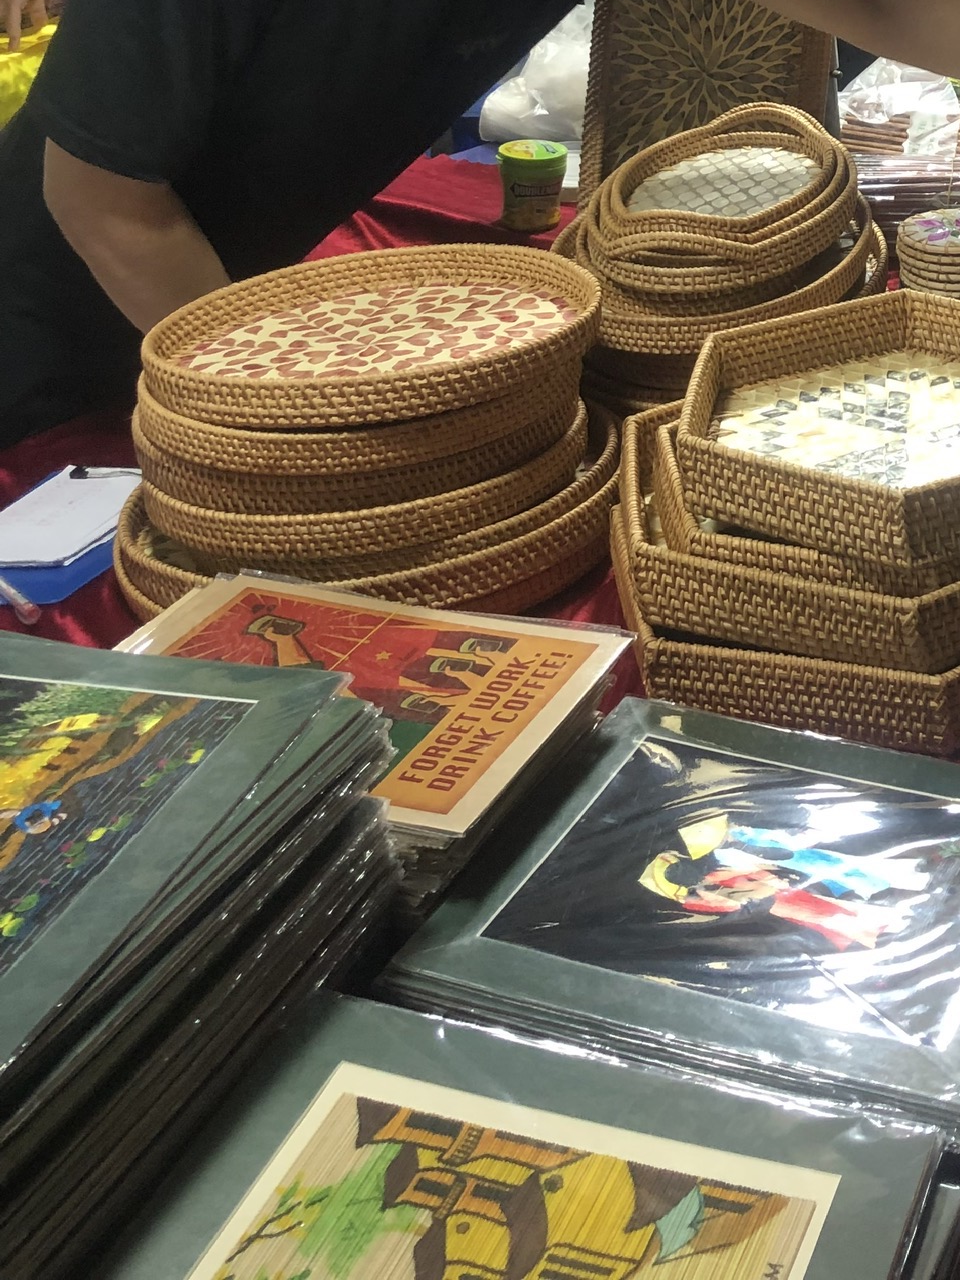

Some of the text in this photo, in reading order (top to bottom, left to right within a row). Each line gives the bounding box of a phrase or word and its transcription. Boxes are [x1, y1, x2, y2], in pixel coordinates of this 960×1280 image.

[397, 652, 541, 784] FORGET WORK.
[426, 651, 574, 792] DRINK COFFEE!
